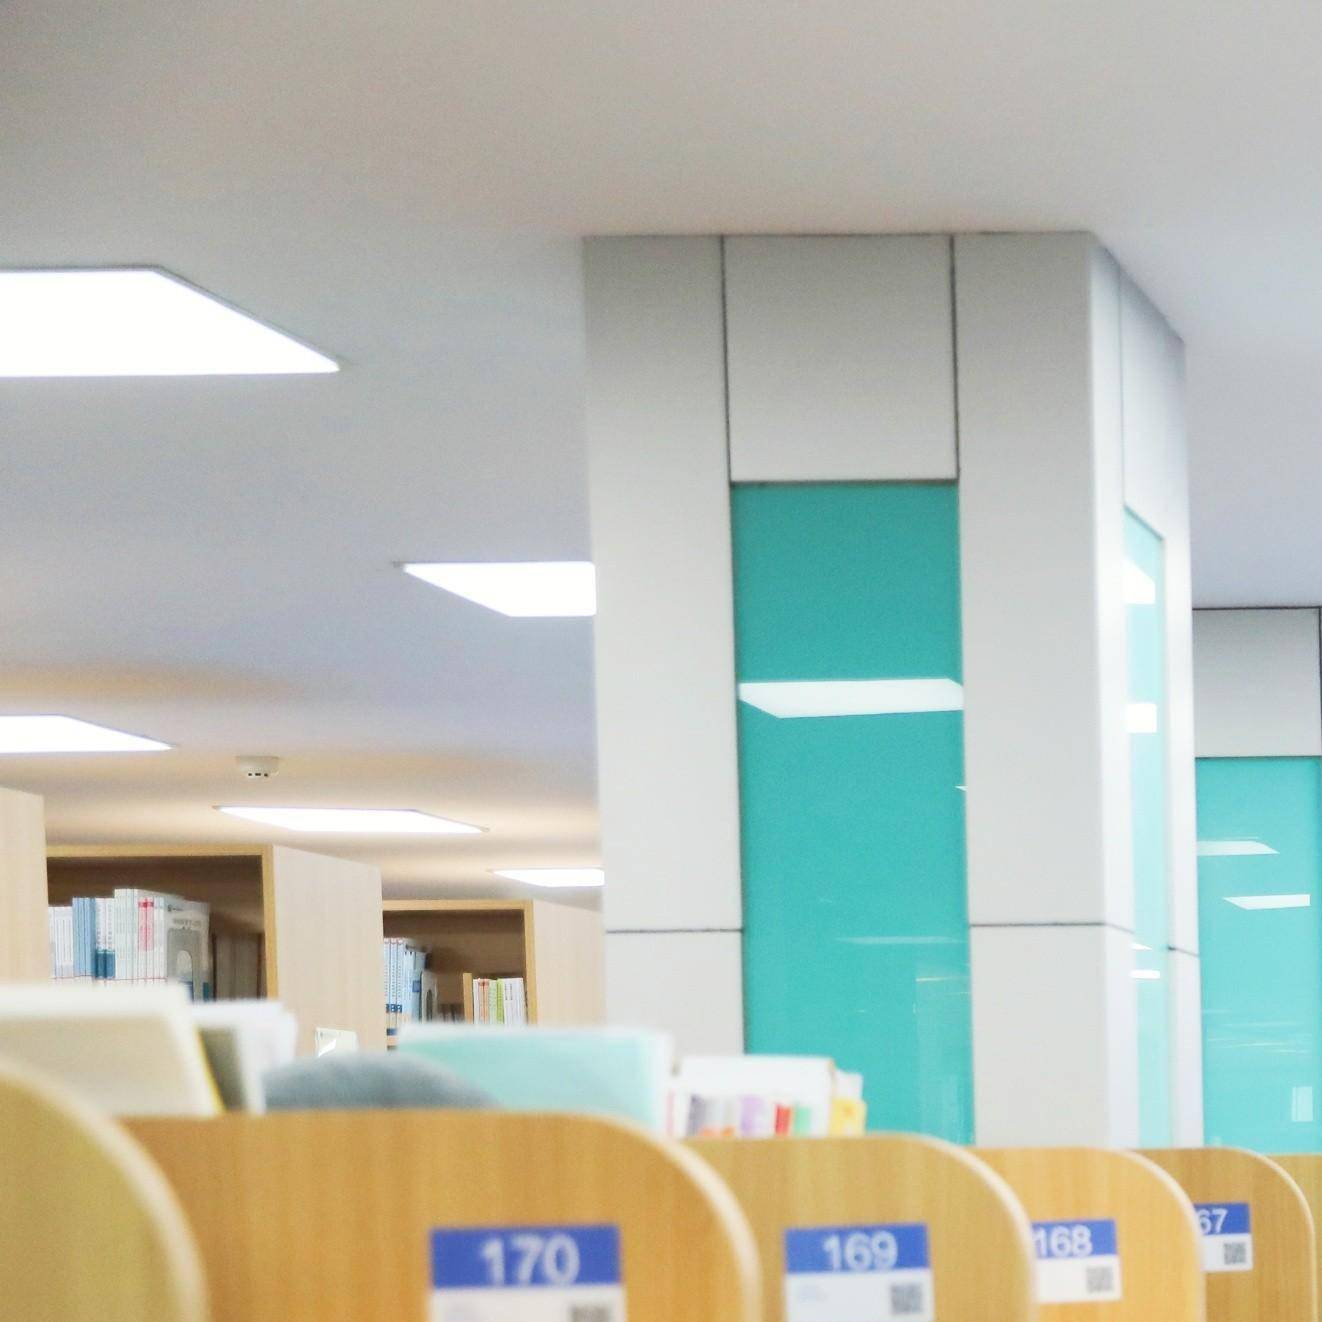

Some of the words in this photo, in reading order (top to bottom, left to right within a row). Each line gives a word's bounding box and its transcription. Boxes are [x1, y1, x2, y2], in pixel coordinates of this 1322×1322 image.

[1195, 1208, 1228, 1235] 67
[481, 1234, 580, 1286] 170
[822, 1230, 898, 1272] 169
[1033, 1225, 1093, 1258] 168
